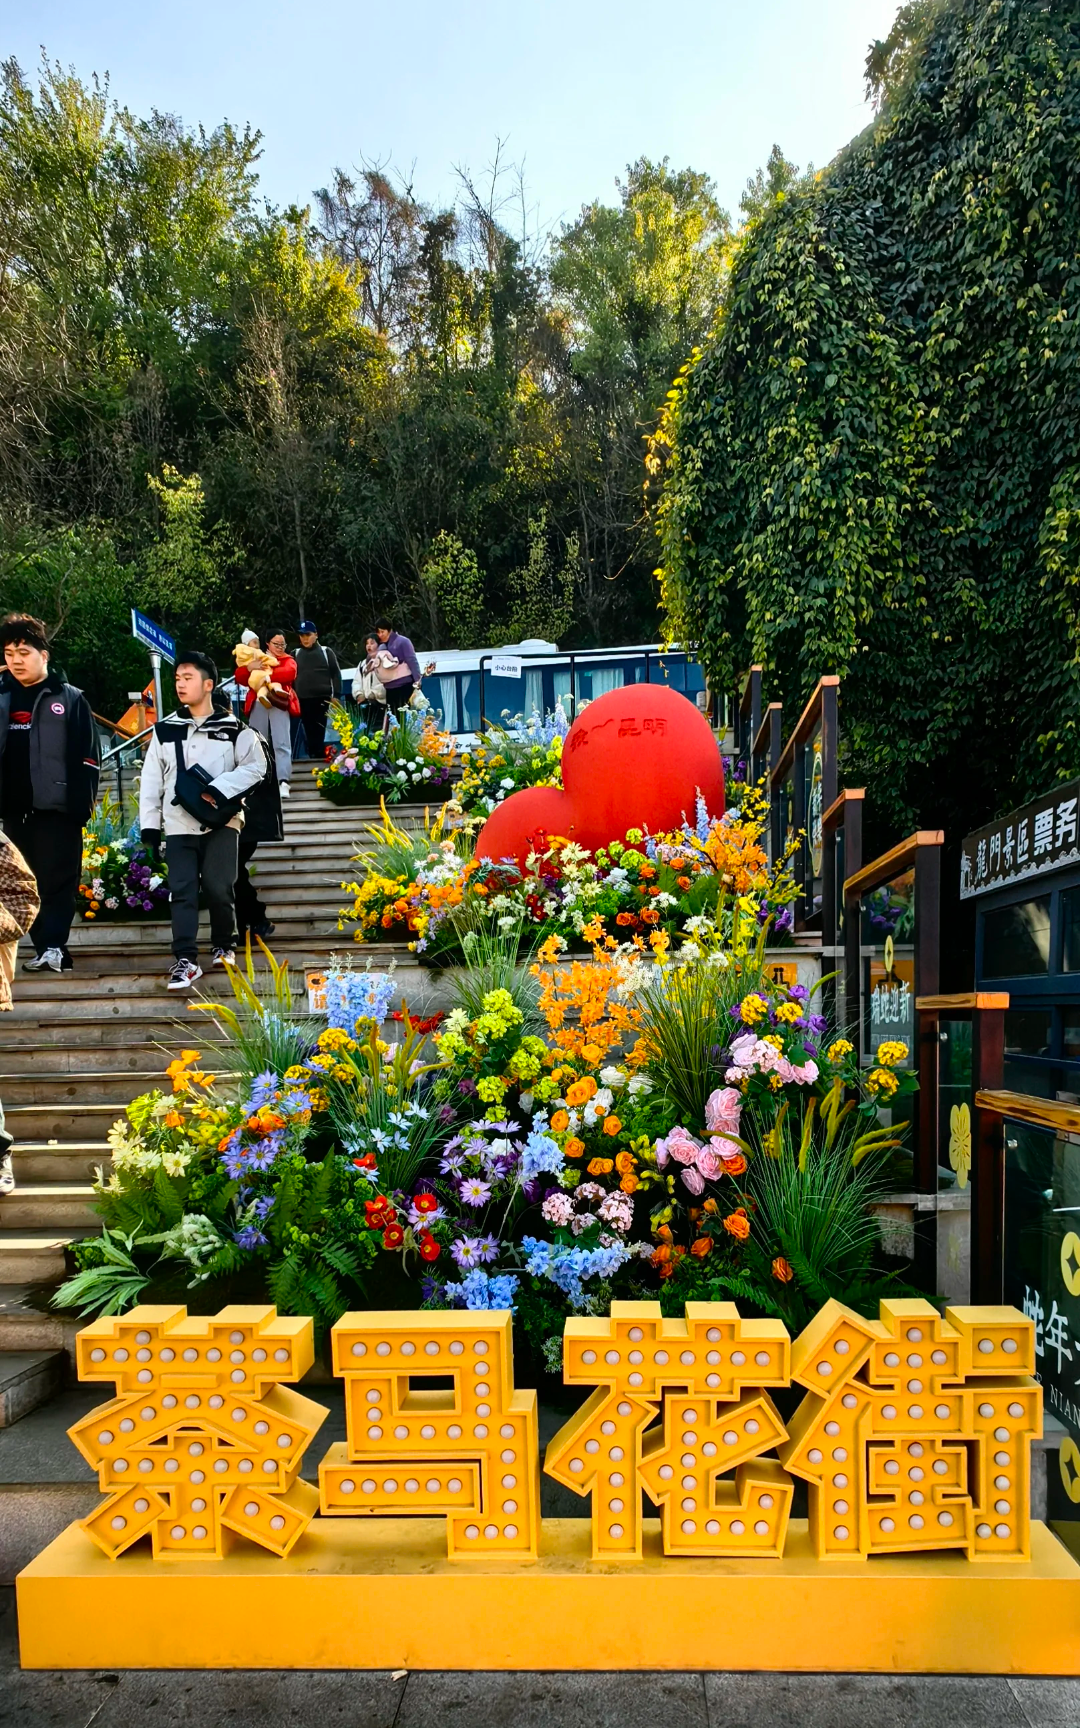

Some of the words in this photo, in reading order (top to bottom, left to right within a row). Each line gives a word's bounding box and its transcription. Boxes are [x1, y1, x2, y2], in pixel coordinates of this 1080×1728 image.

[1023, 1284, 1080, 1386] 蛇年
[67, 1297, 1044, 1562] 茶马花街
